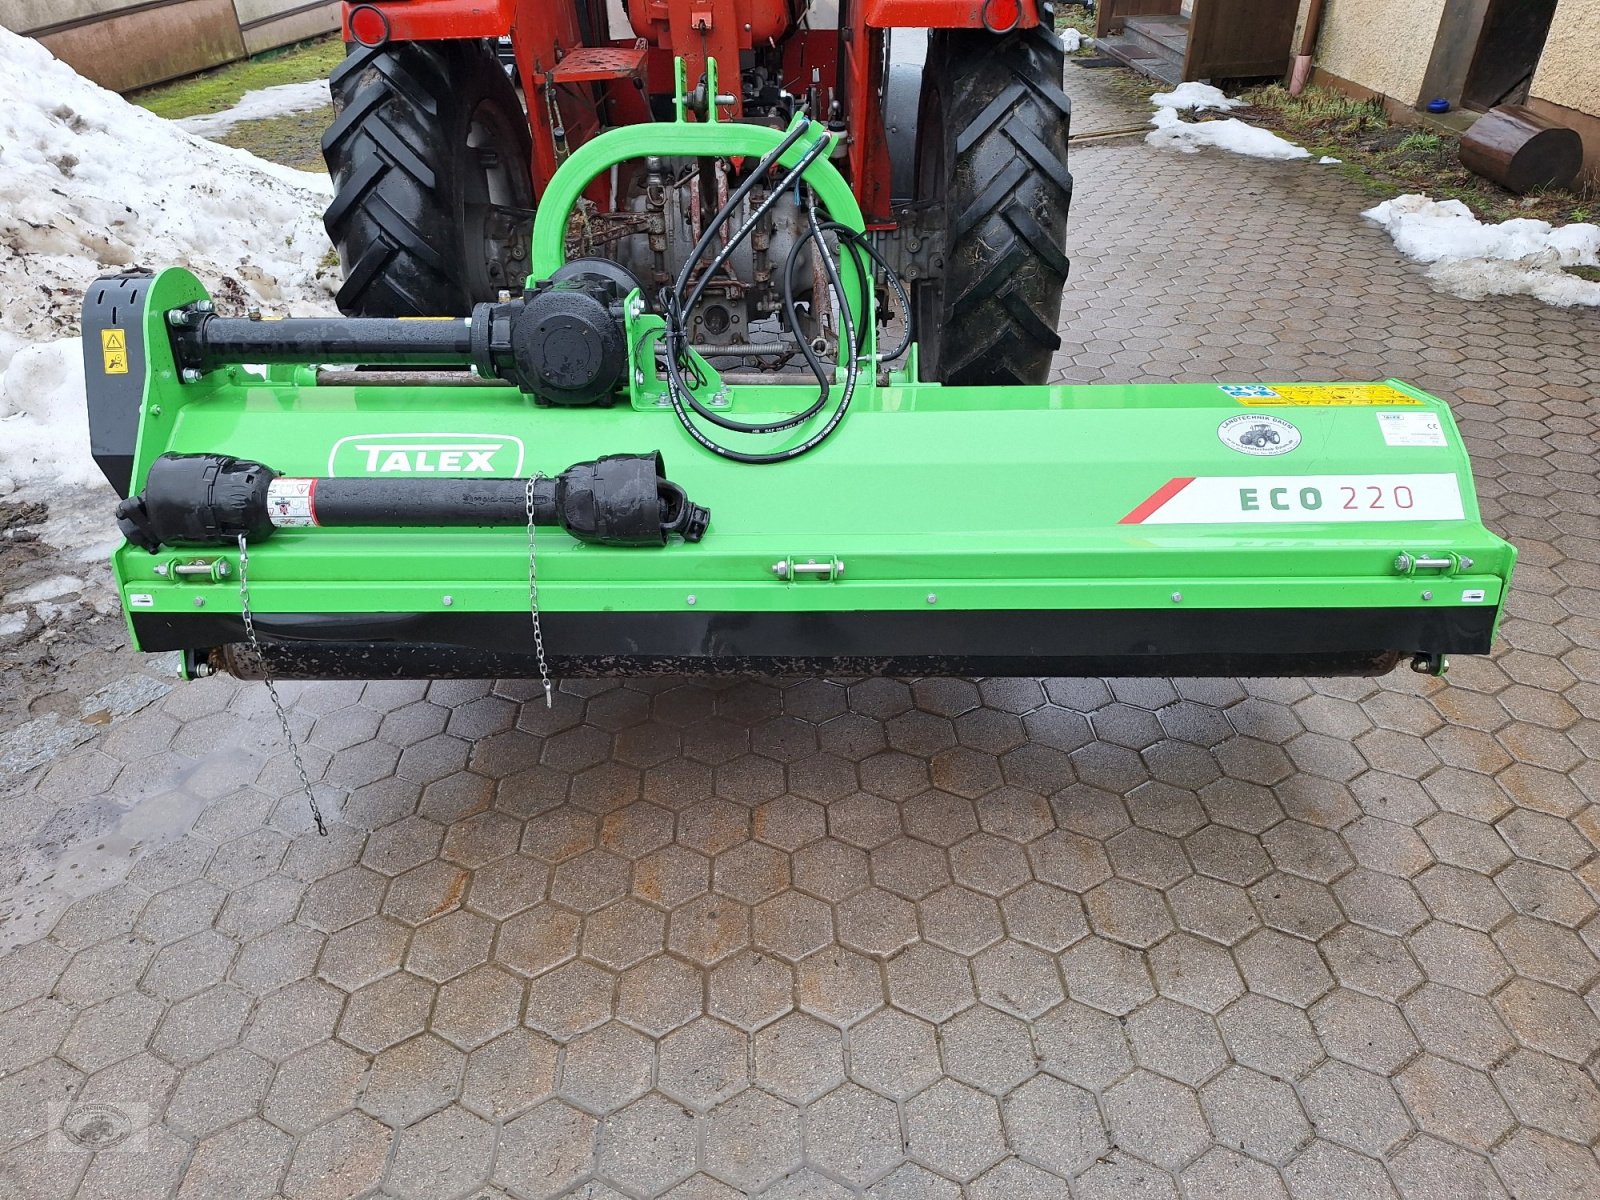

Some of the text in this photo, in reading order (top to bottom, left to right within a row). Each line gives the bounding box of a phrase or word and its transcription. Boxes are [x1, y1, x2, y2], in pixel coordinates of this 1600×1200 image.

[1222, 415, 1271, 429] LANDTECHNIK
[354, 443, 504, 472] TALEX
[1239, 485, 1414, 511] ECO 220
